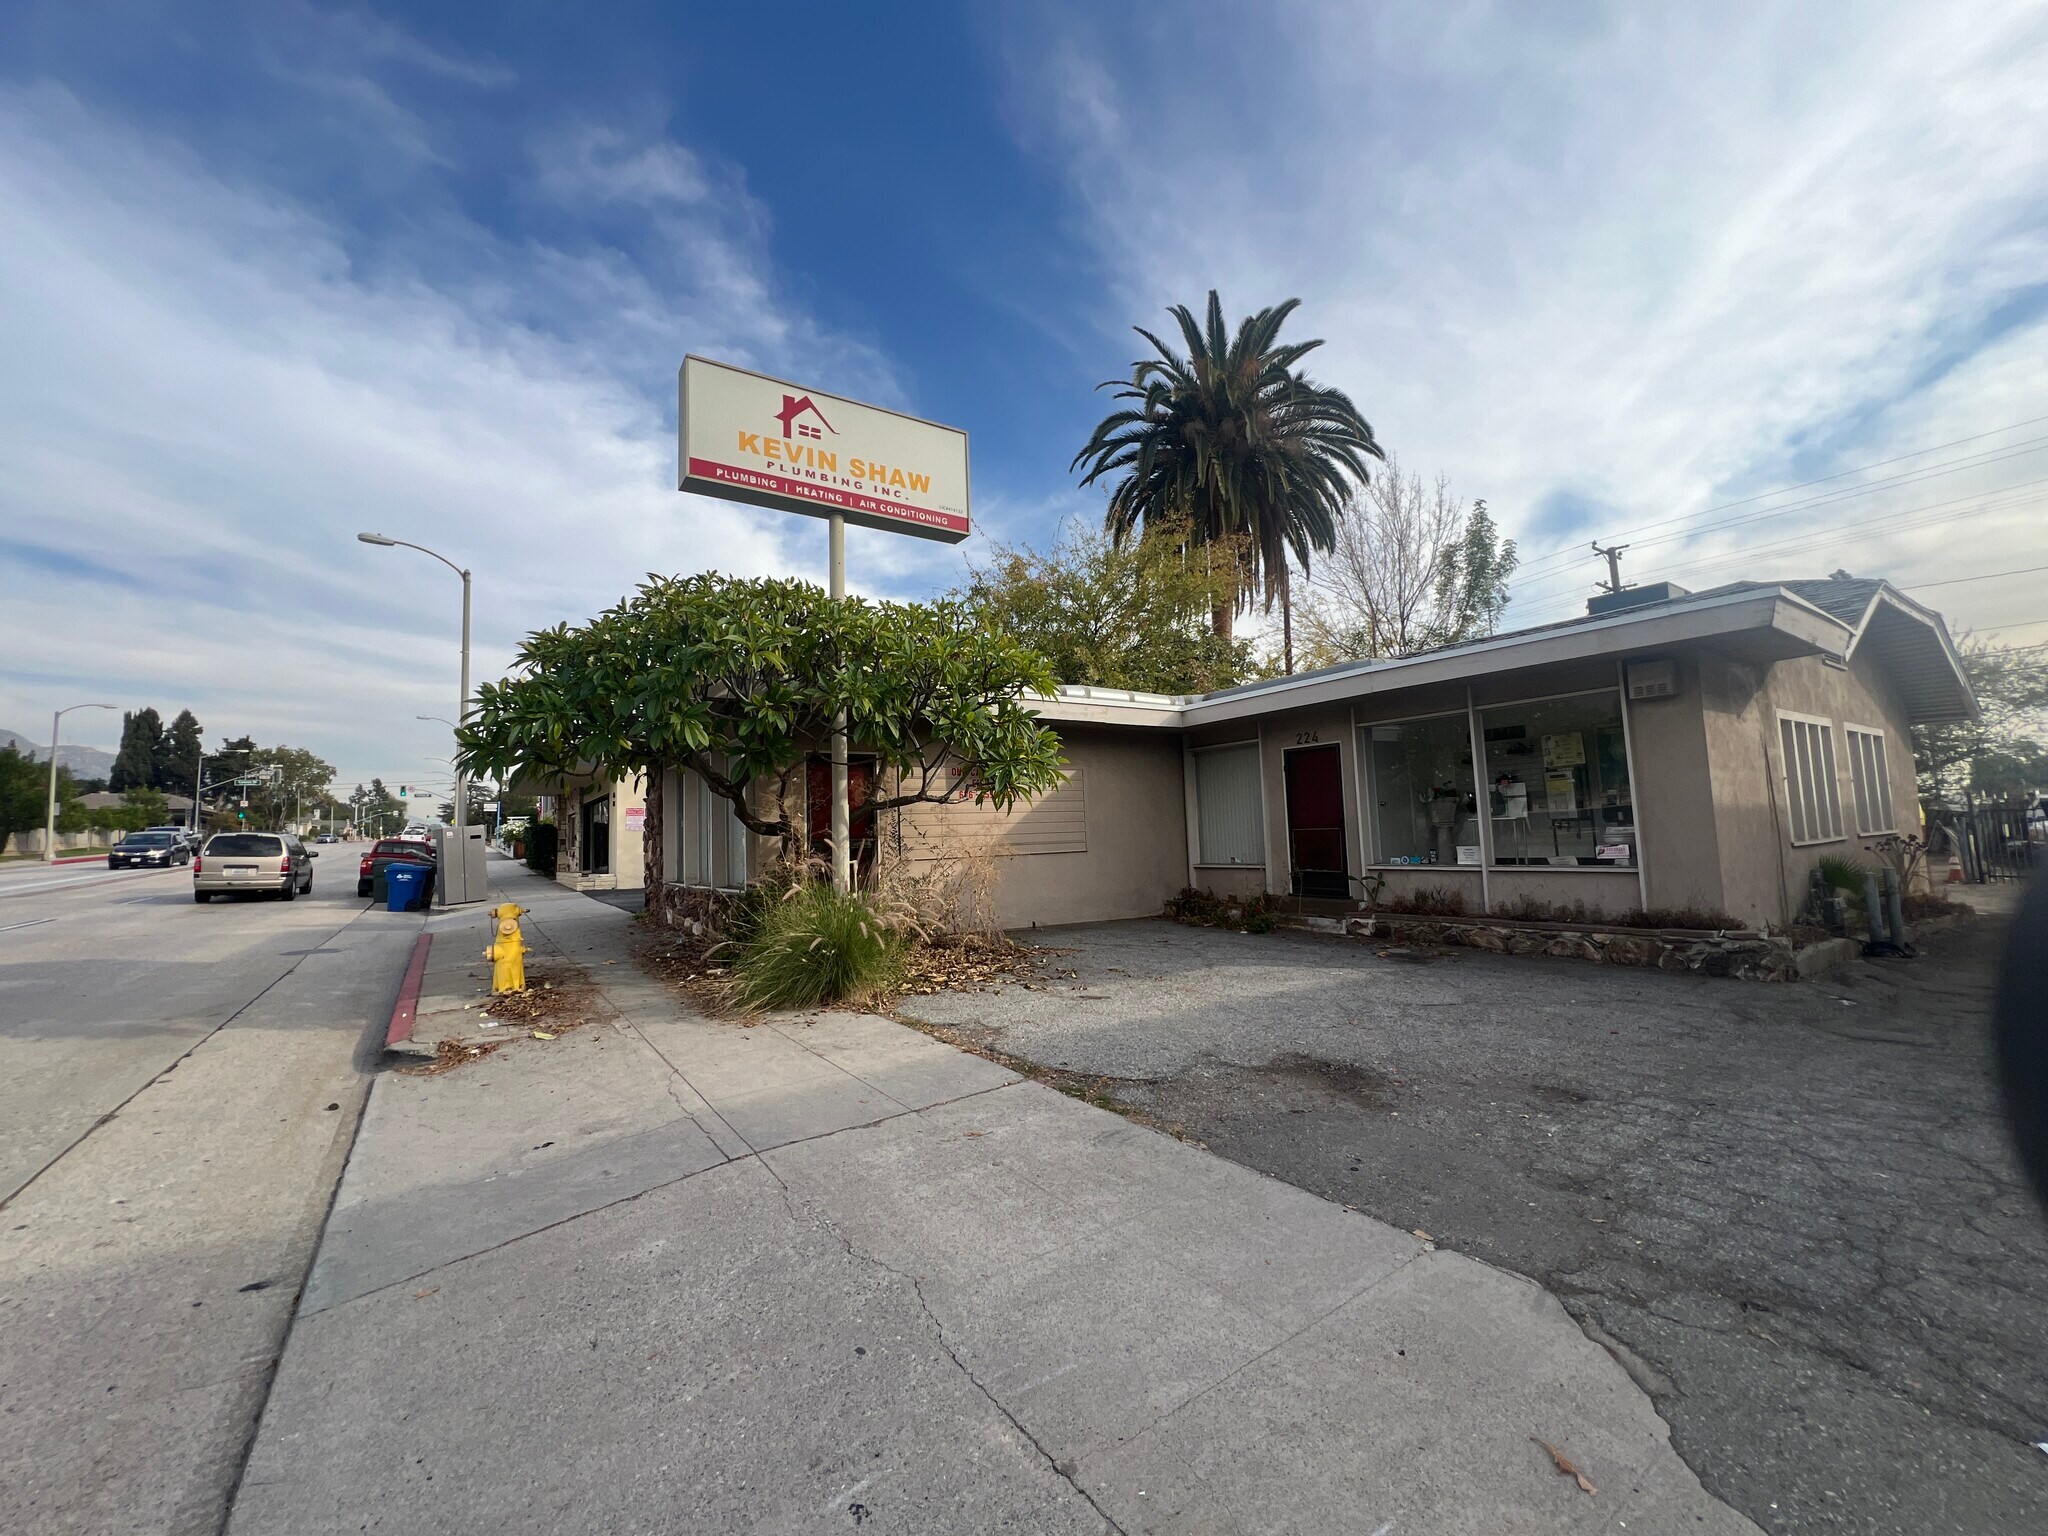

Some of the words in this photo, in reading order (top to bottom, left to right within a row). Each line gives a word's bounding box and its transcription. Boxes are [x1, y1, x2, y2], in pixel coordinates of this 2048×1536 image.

[738, 431, 837, 472] KEVIN
[849, 458, 931, 493] SHAW
[766, 460, 863, 489] PLUMBING
[873, 485, 909, 500] INC.
[716, 468, 777, 489] PLUMBING
[795, 485, 843, 503] HEATING
[859, 498, 876, 511] AIR
[880, 503, 948, 525] CONDITIONING
[1295, 731, 1319, 745] 224
